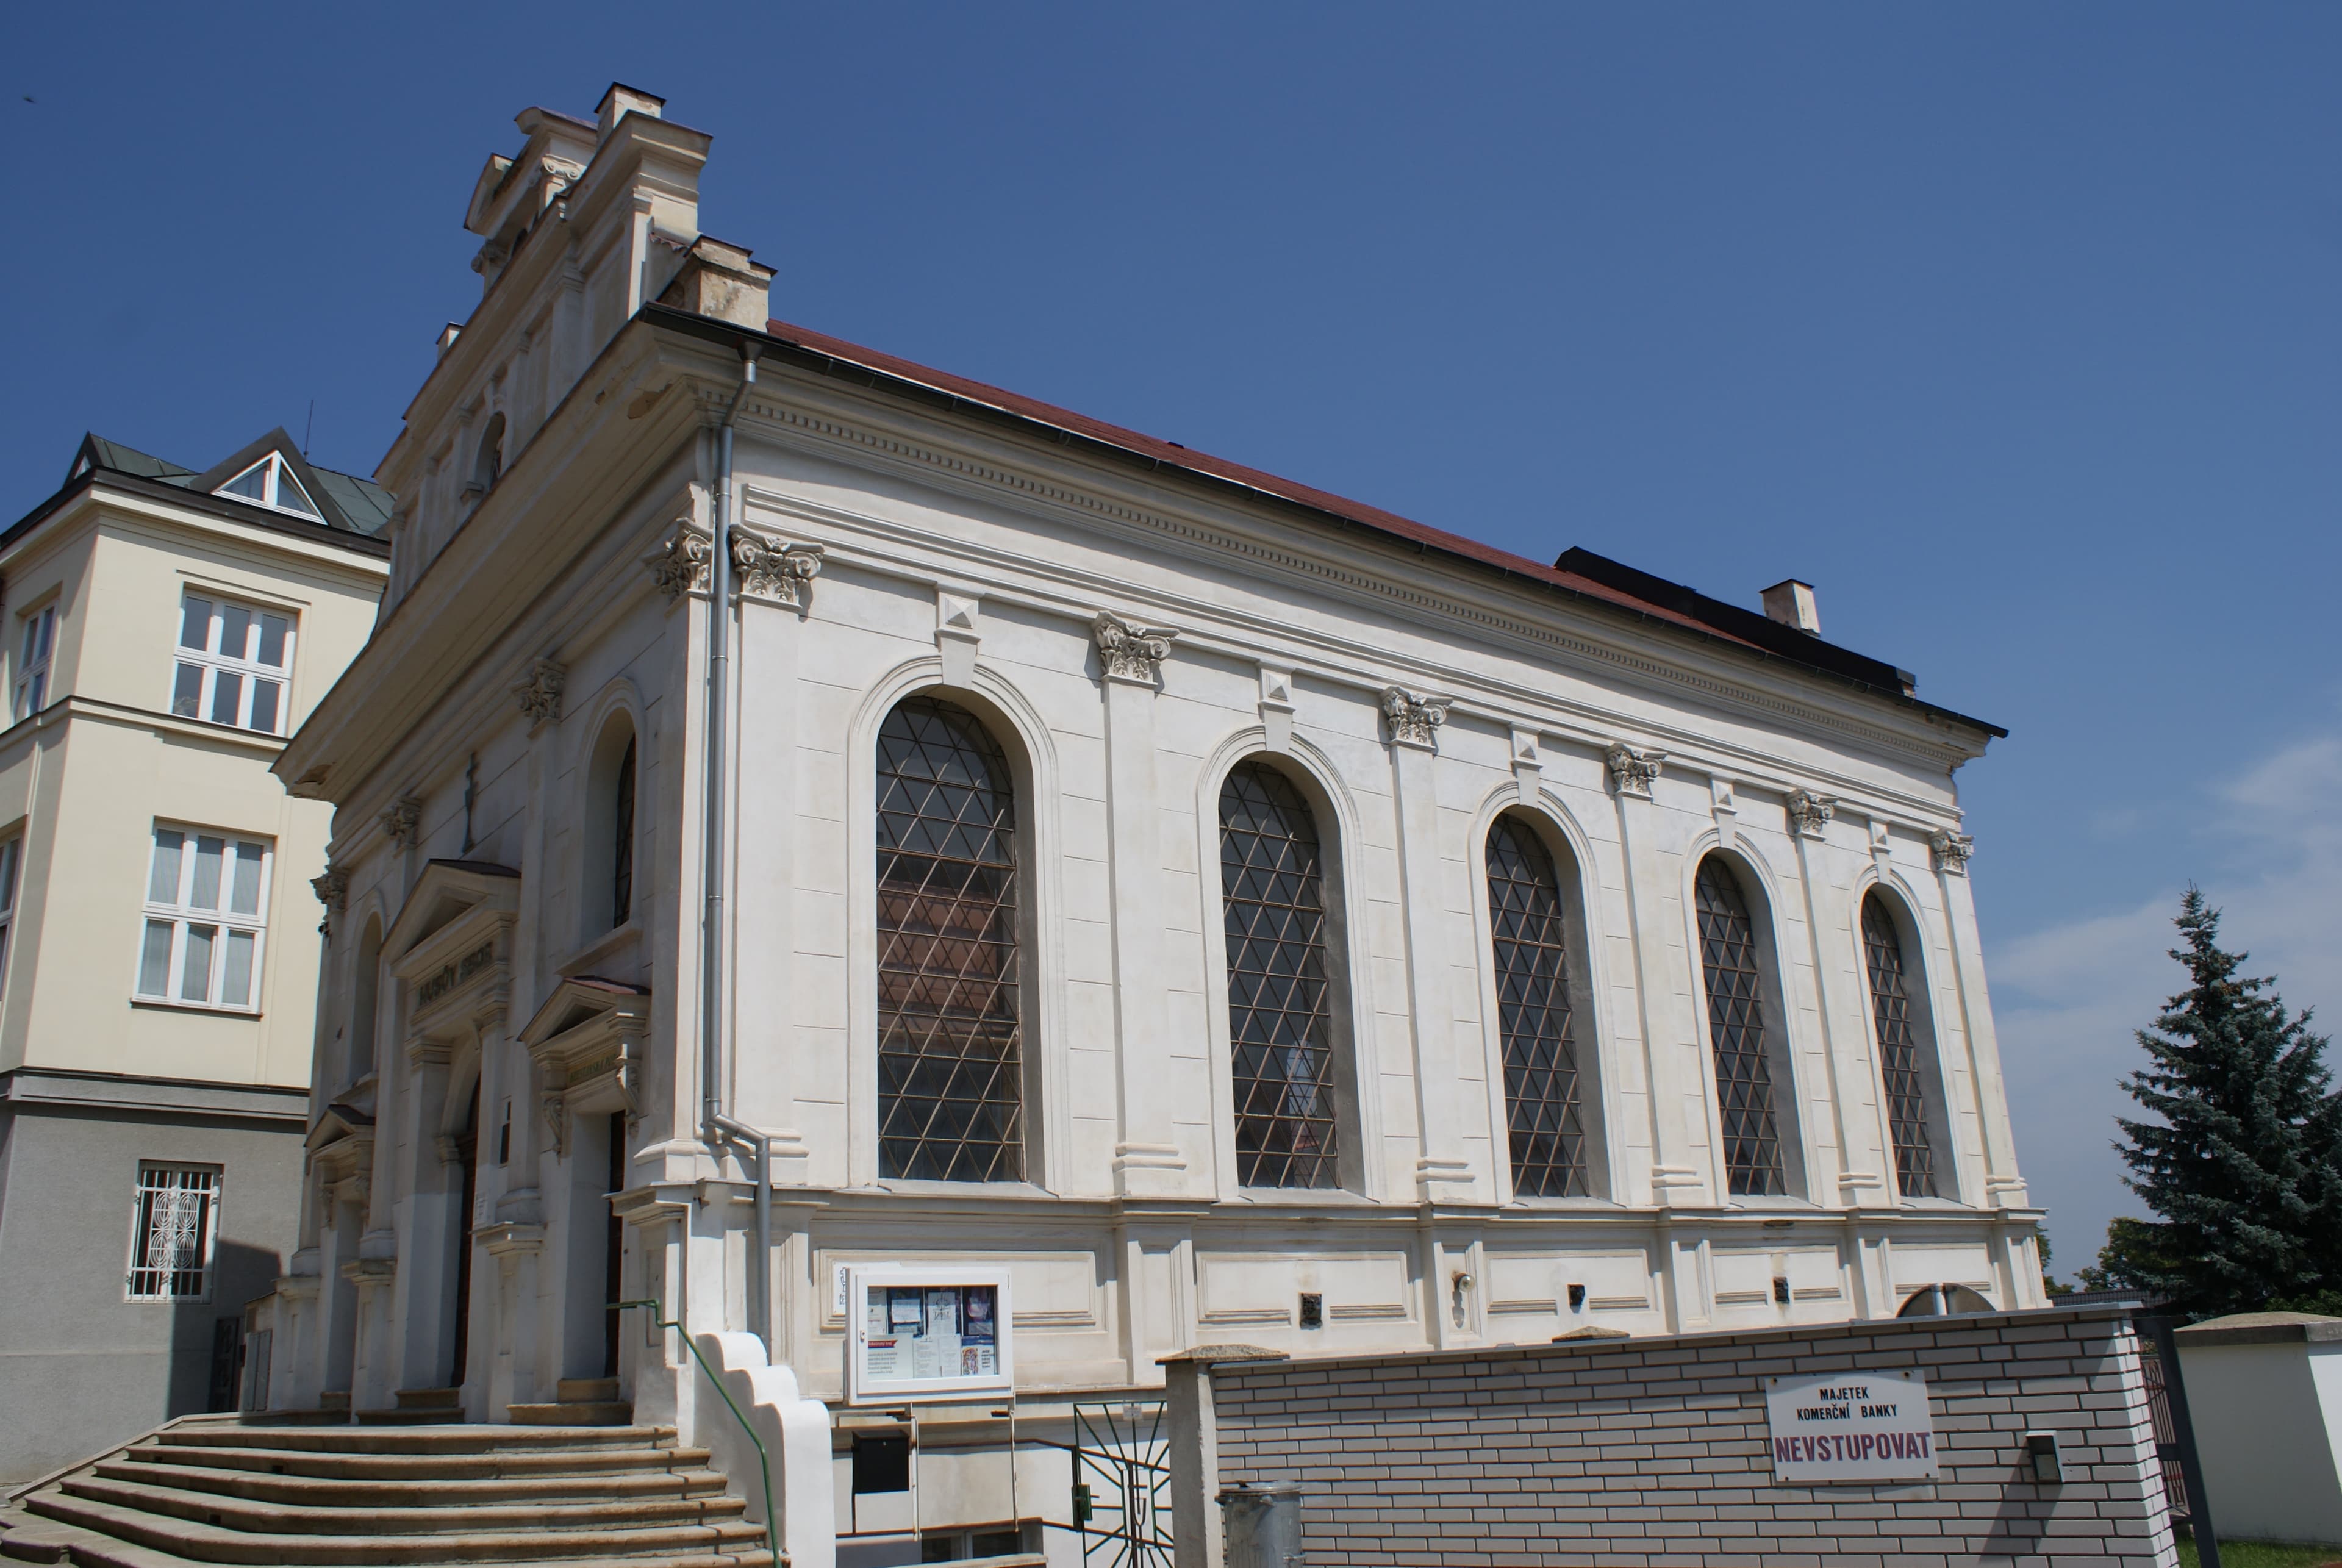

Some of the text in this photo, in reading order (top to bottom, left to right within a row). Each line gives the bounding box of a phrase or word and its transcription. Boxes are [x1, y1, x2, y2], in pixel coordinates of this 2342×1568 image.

[1819, 1386, 1869, 1400] MAJETEK
[1797, 1402, 1897, 1420] KOMERČNÍ BANKY
[1775, 1432, 1930, 1462] NEVSTUPOVAT
